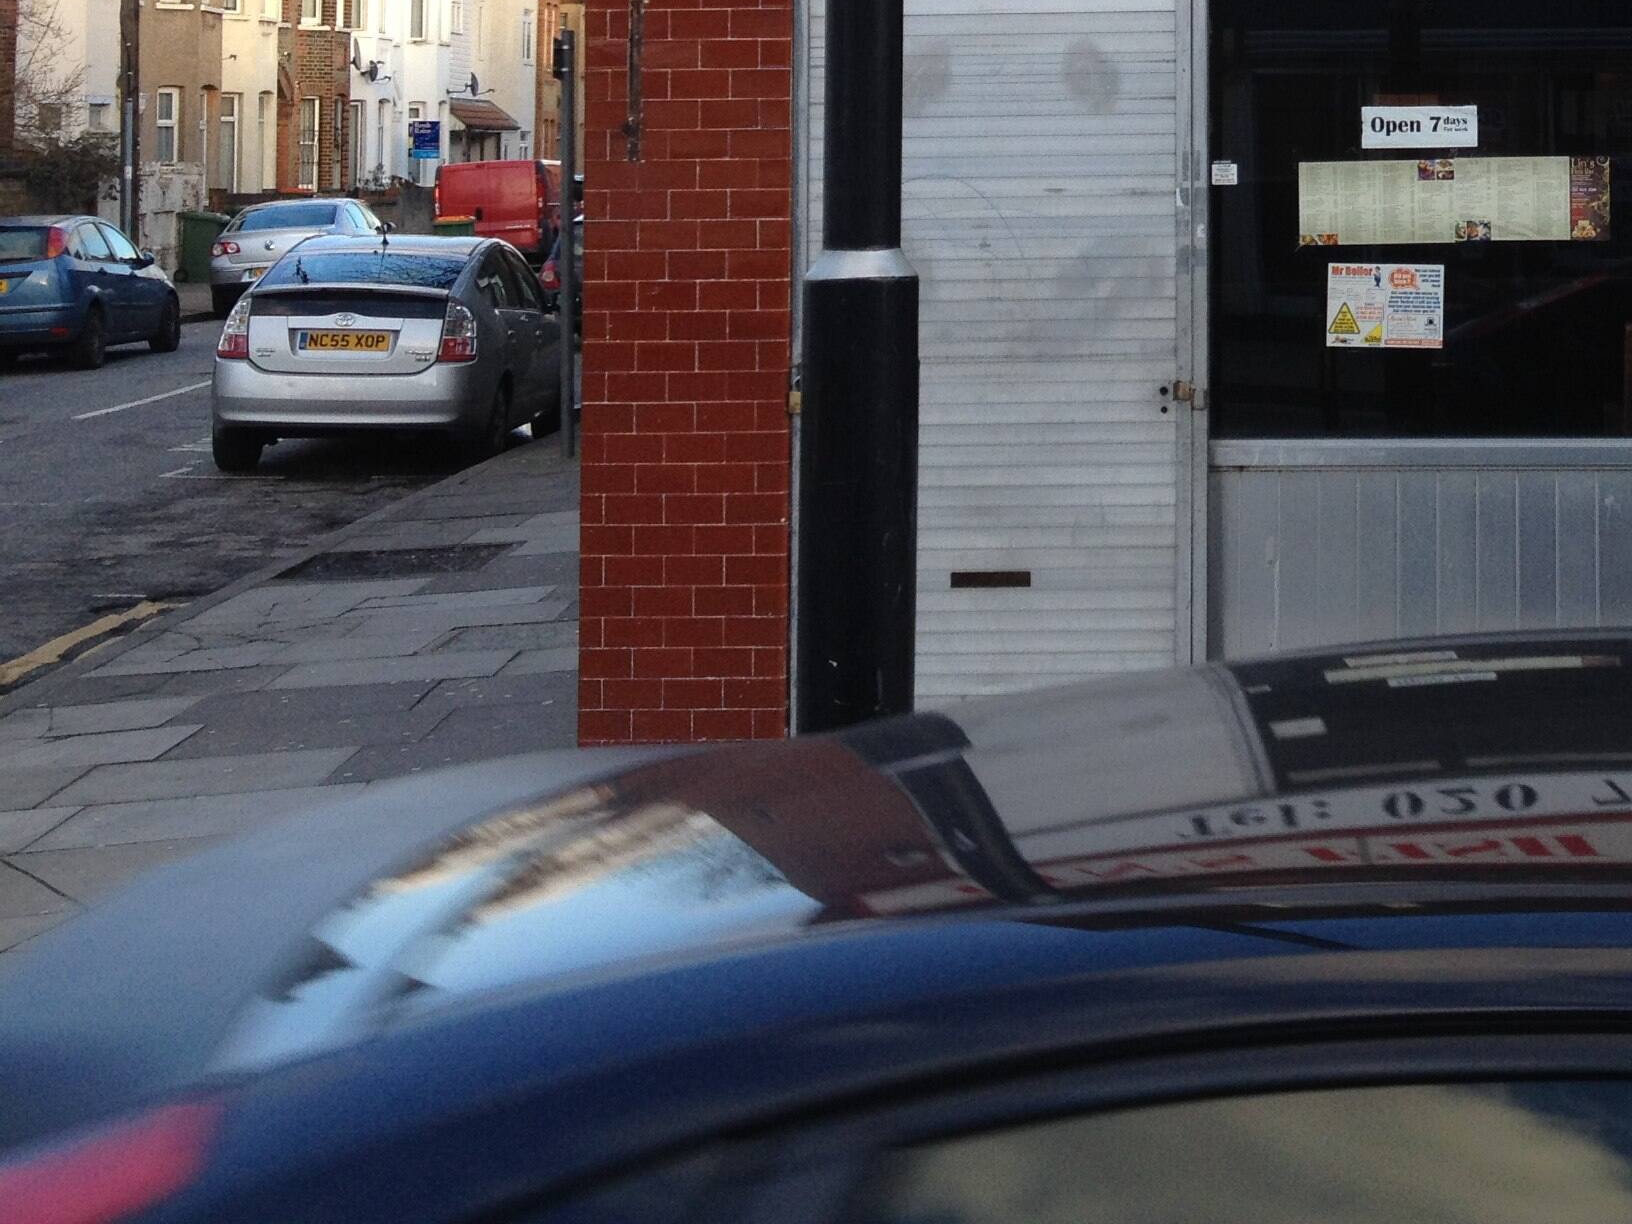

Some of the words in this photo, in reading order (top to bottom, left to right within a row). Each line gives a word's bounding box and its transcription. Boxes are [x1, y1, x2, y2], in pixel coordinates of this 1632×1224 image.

[1370, 116, 1421, 136] Open
[1429, 116, 1442, 133] 7
[1443, 116, 1468, 127] days
[307, 333, 350, 348] NC55
[354, 333, 386, 349] XOP
